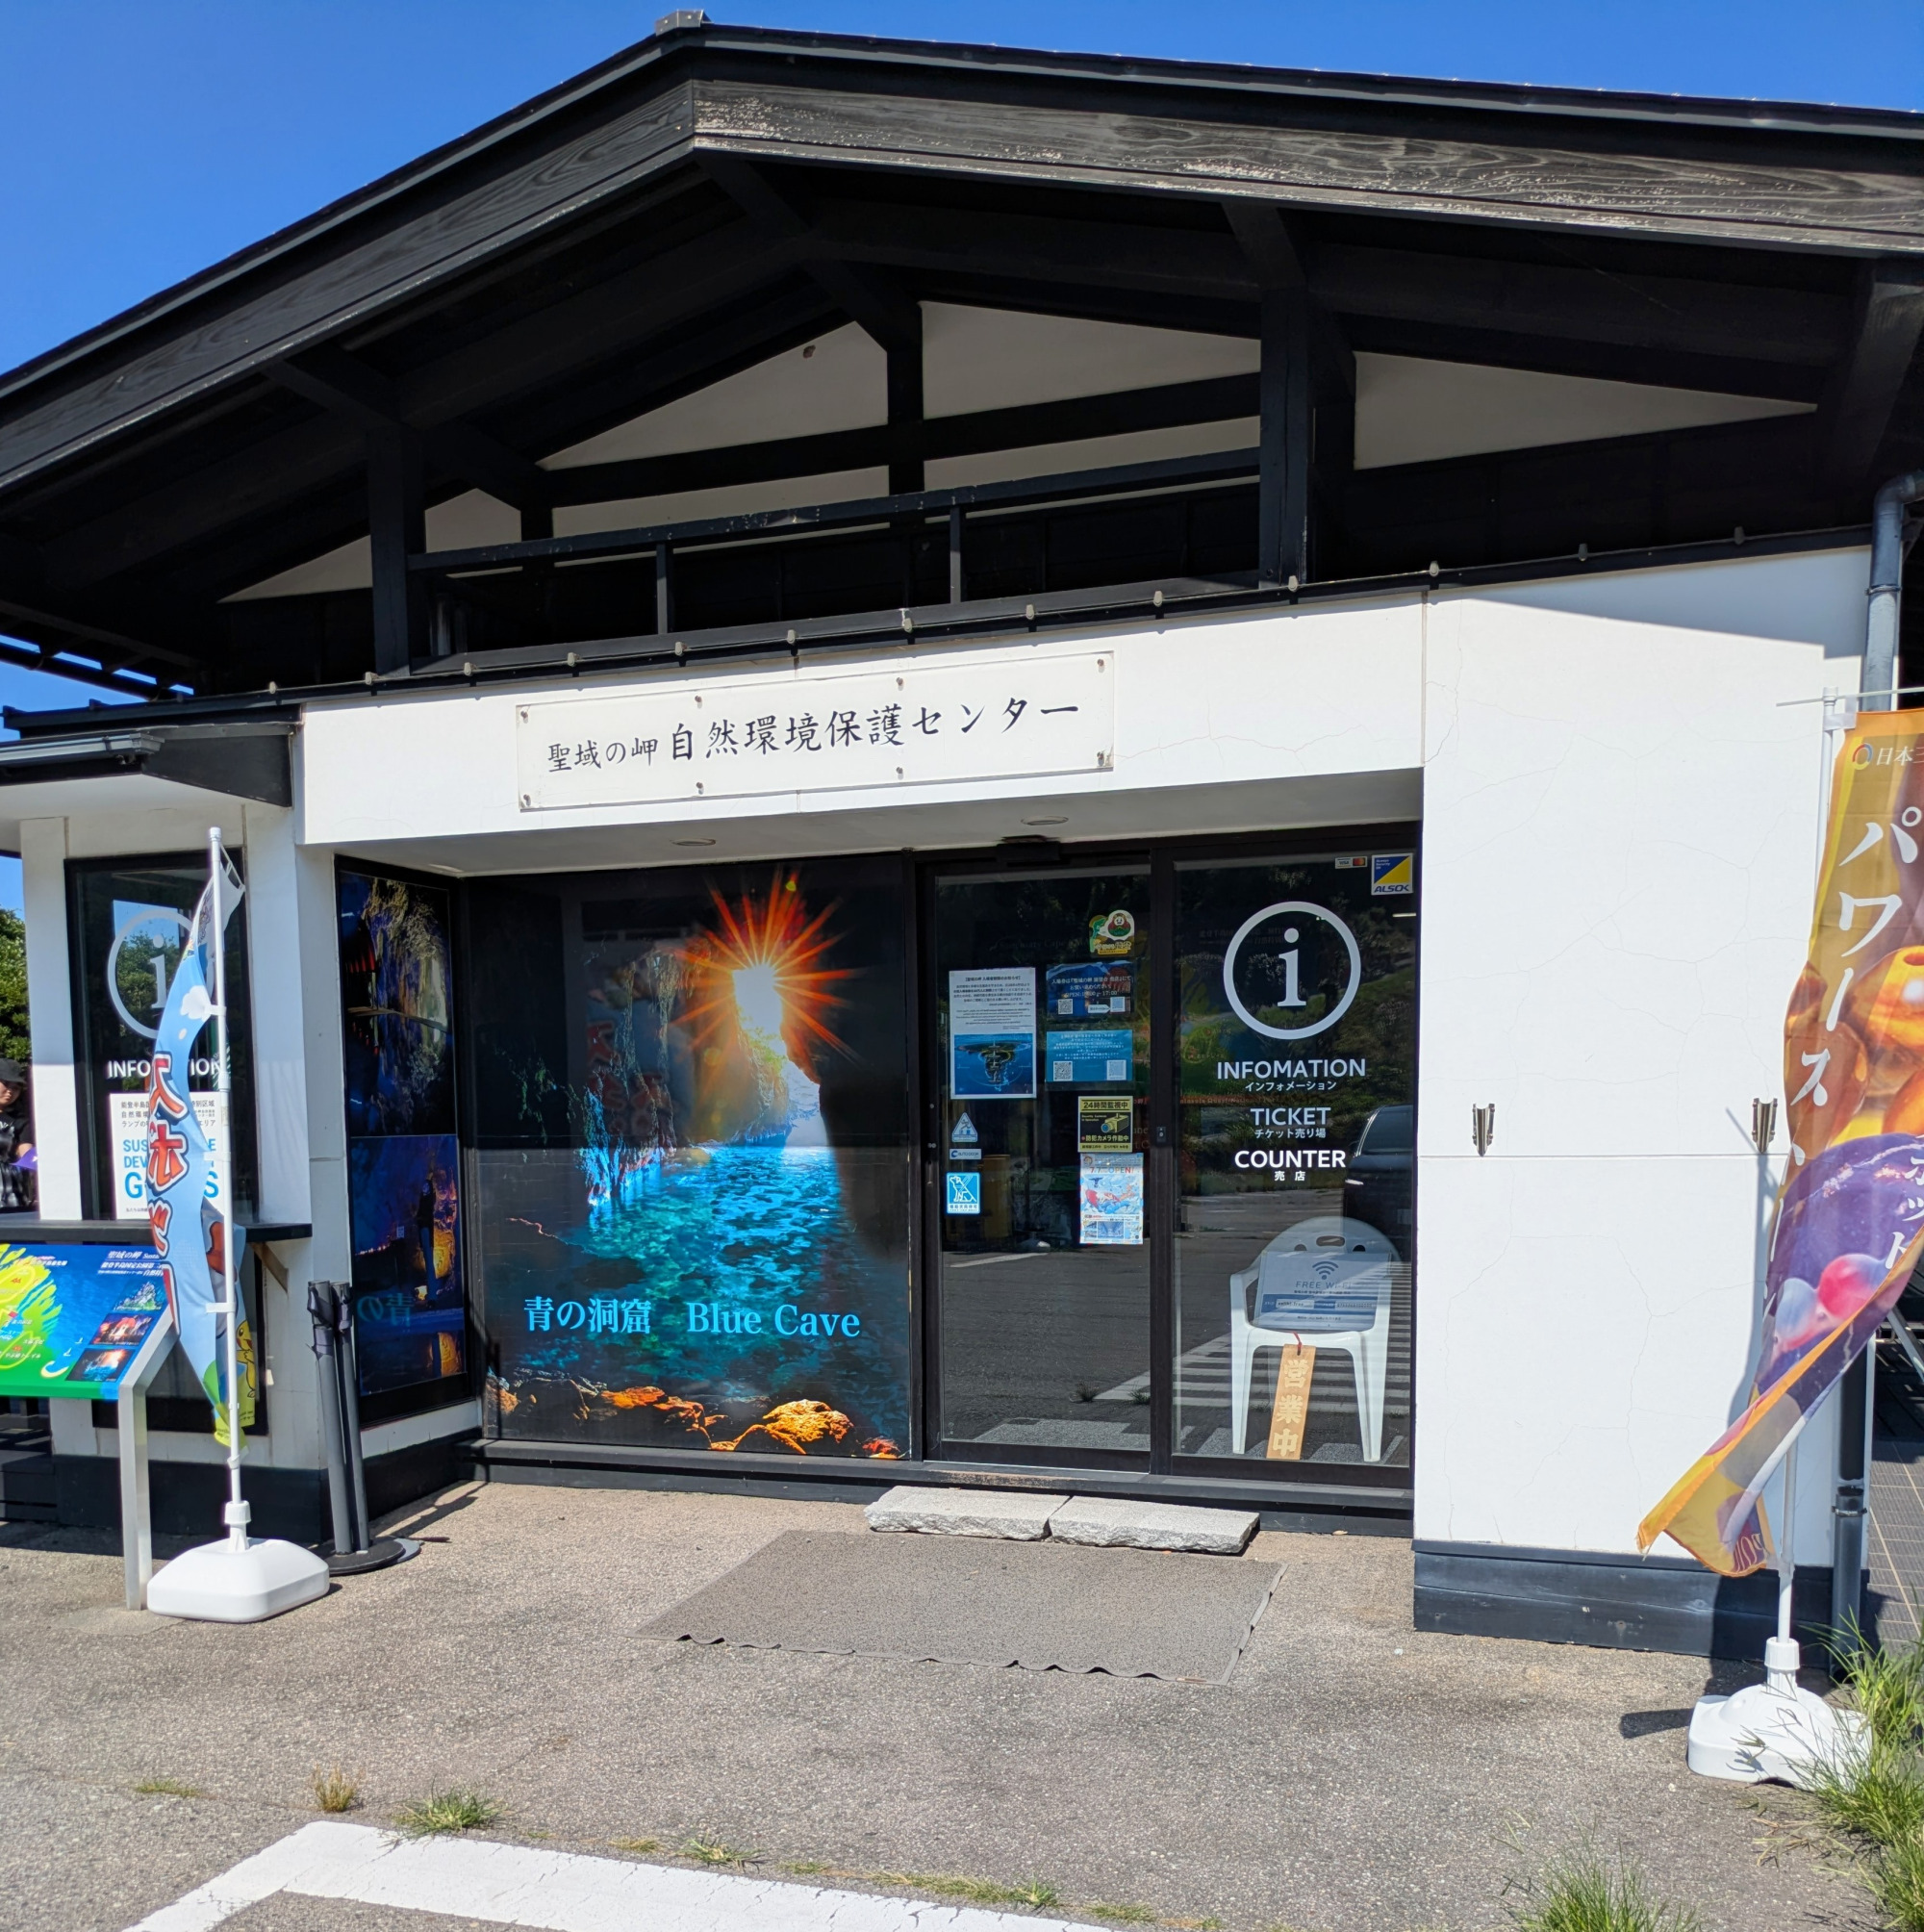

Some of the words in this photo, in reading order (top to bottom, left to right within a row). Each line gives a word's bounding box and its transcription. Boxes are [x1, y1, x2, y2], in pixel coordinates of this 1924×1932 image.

[547, 736, 658, 774] 聖域の岬
[671, 697, 1080, 761] 自然環境保護センター
[1374, 884, 1409, 893] ALSOK
[1217, 1058, 1366, 1080] INFOMATION
[1244, 1080, 1336, 1091] インフォメーション
[1251, 1107, 1330, 1126] TICKET
[1254, 1128, 1327, 1138] チケット売り場
[1234, 1150, 1347, 1168] COUNTER
[1296, 1281, 1320, 1289] FREE
[523, 1296, 652, 1335] 青の洞窟
[688, 1302, 762, 1335] Blue
[774, 1304, 860, 1337] Cave
[1272, 1359, 1309, 1457] 営業中
